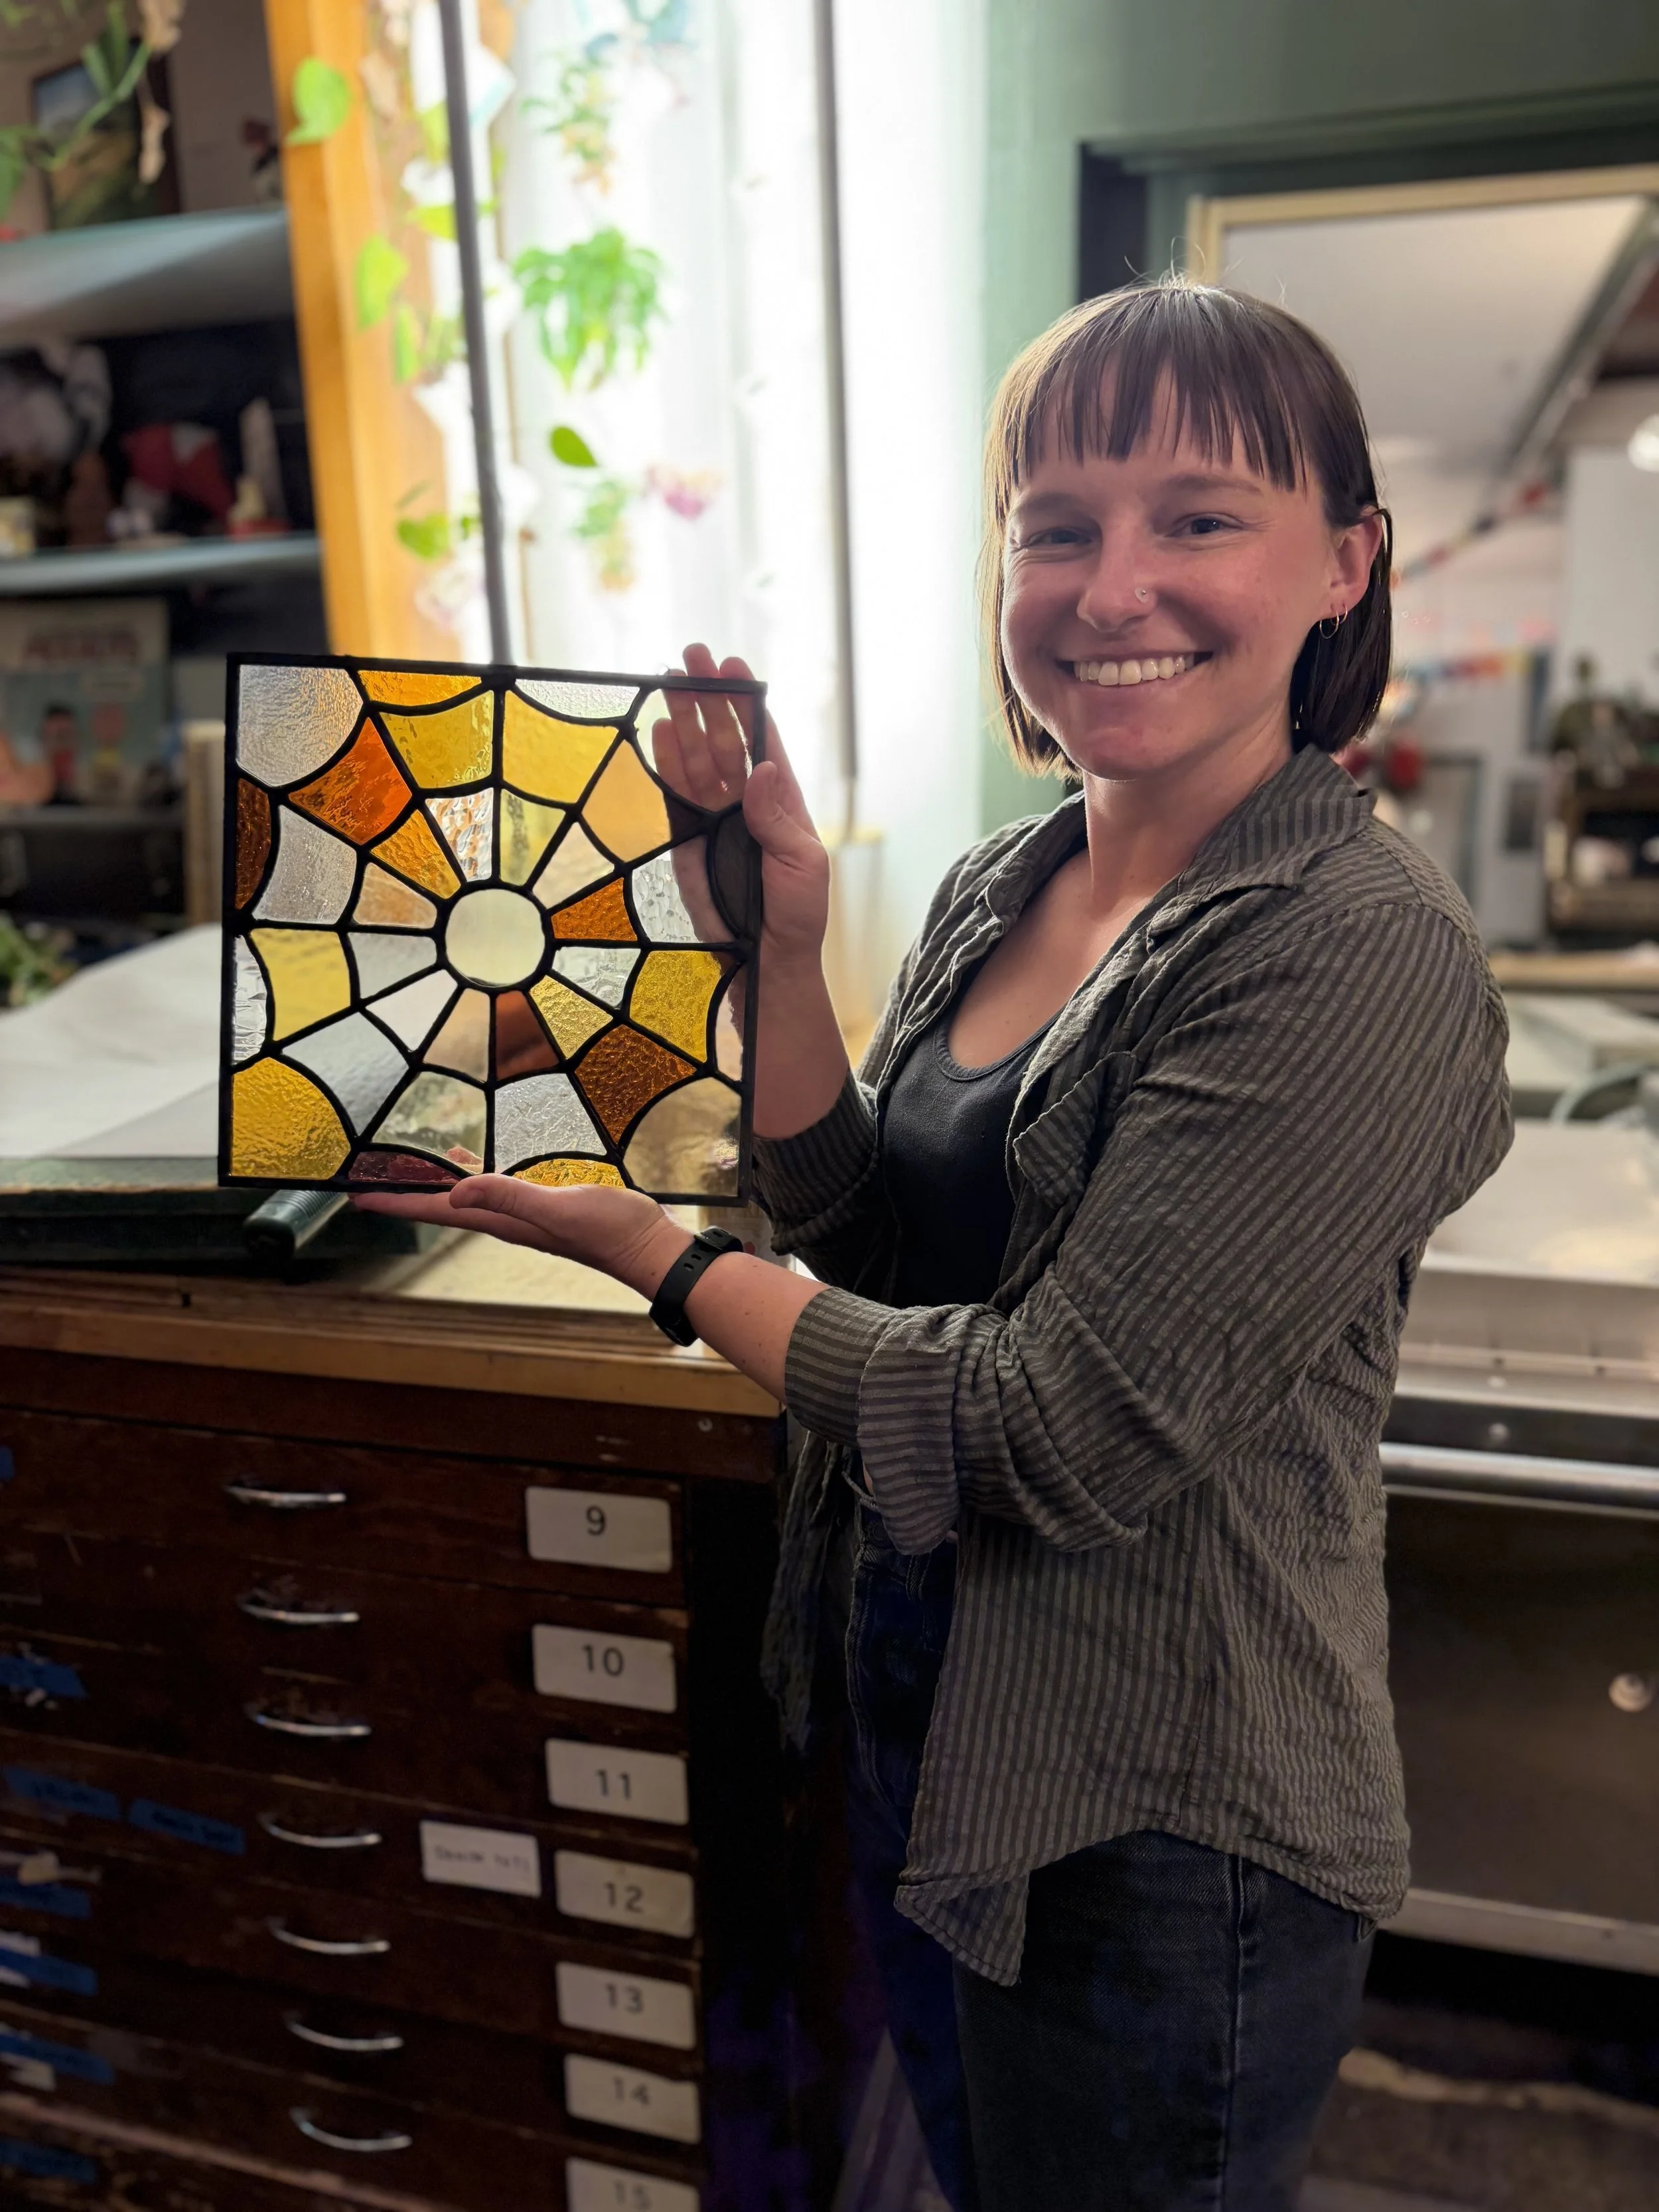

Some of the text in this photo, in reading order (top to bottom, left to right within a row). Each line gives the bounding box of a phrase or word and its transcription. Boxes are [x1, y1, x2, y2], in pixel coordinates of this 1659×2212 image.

[586, 1505, 607, 1536] 9
[582, 1643, 625, 1678] 10
[596, 1768, 632, 1800] 11
[605, 1881, 644, 1913] 12
[604, 1982, 644, 2016] 13
[612, 2076, 650, 2107] 14
